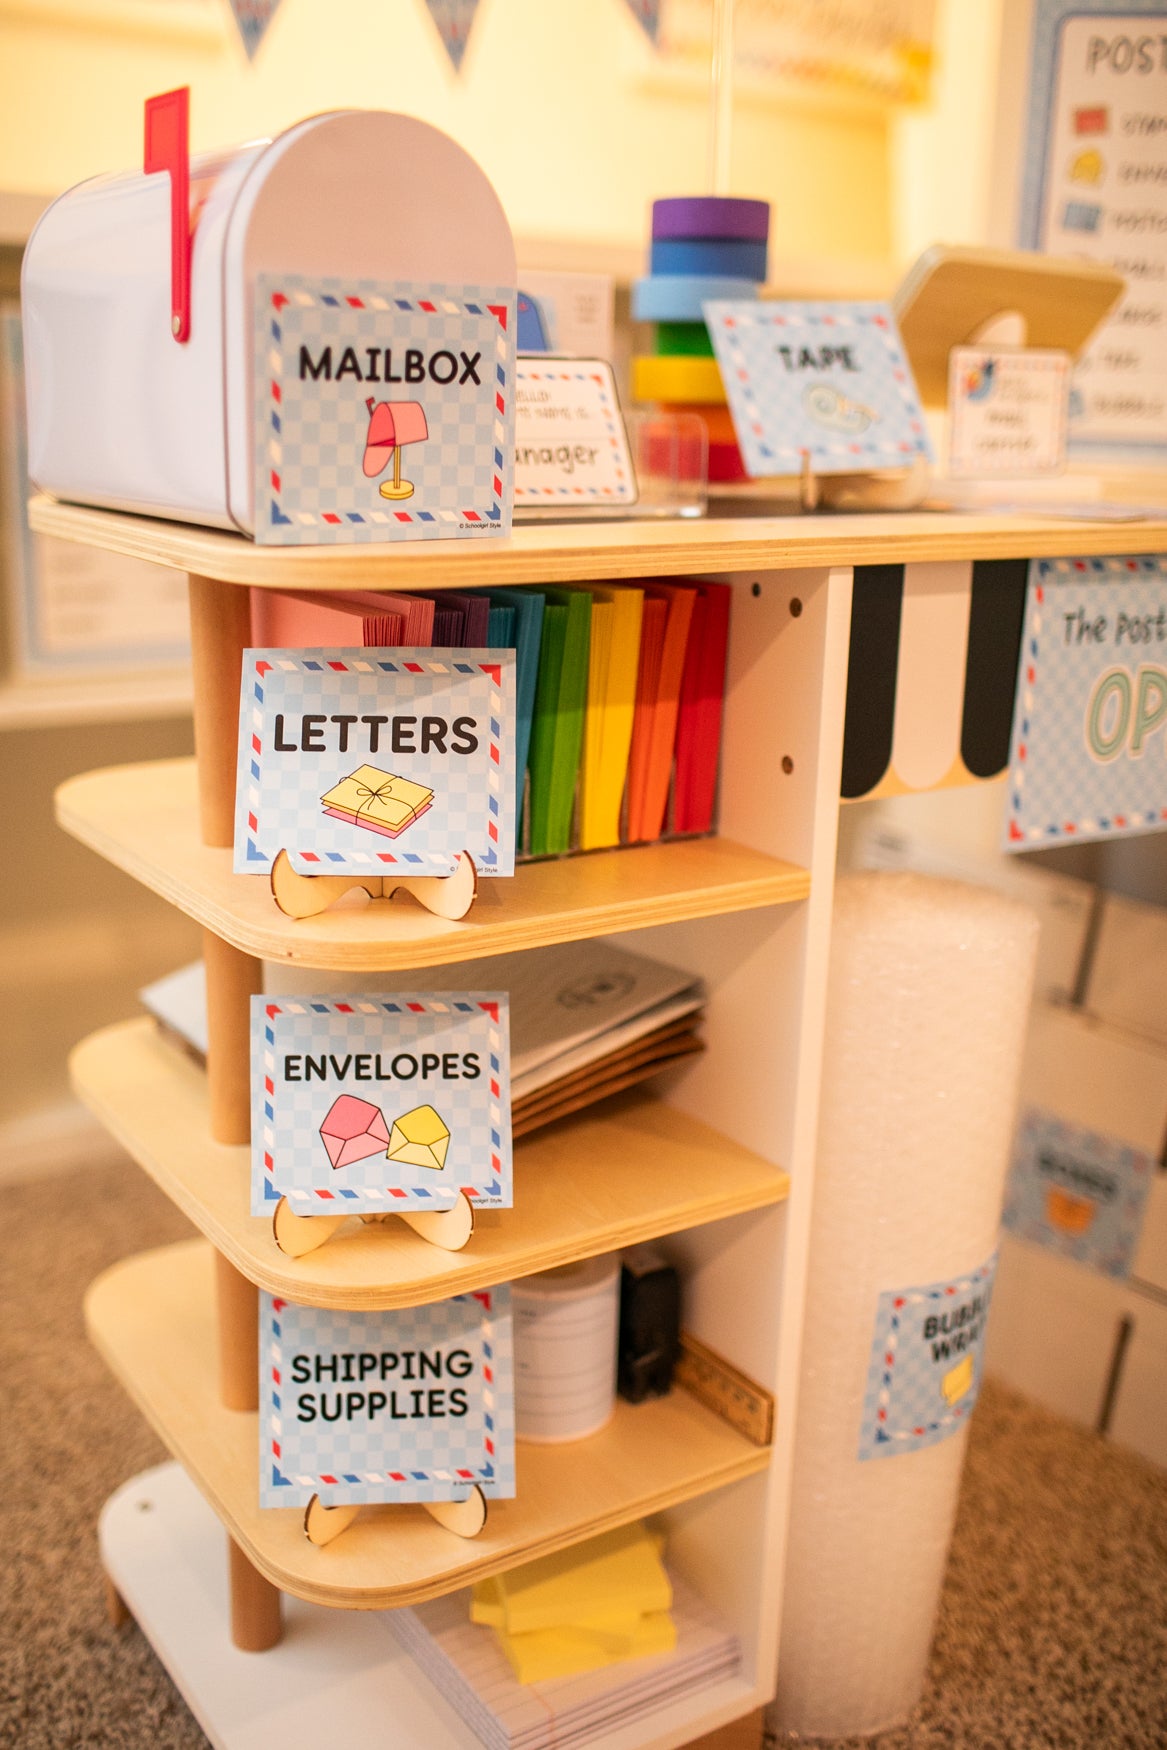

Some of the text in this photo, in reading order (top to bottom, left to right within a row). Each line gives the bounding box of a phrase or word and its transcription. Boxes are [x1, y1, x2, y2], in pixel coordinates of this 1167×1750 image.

[299, 345, 482, 386] MAILBOX
[777, 344, 860, 373] TAPE
[465, 522, 489, 530] Schoolgirl
[1063, 604, 1107, 647] The
[274, 714, 479, 755] LETTERS
[284, 1053, 481, 1082] ENVELOPES
[291, 1350, 474, 1384] SHIPPING
[297, 1388, 469, 1423] SUPPLIES
